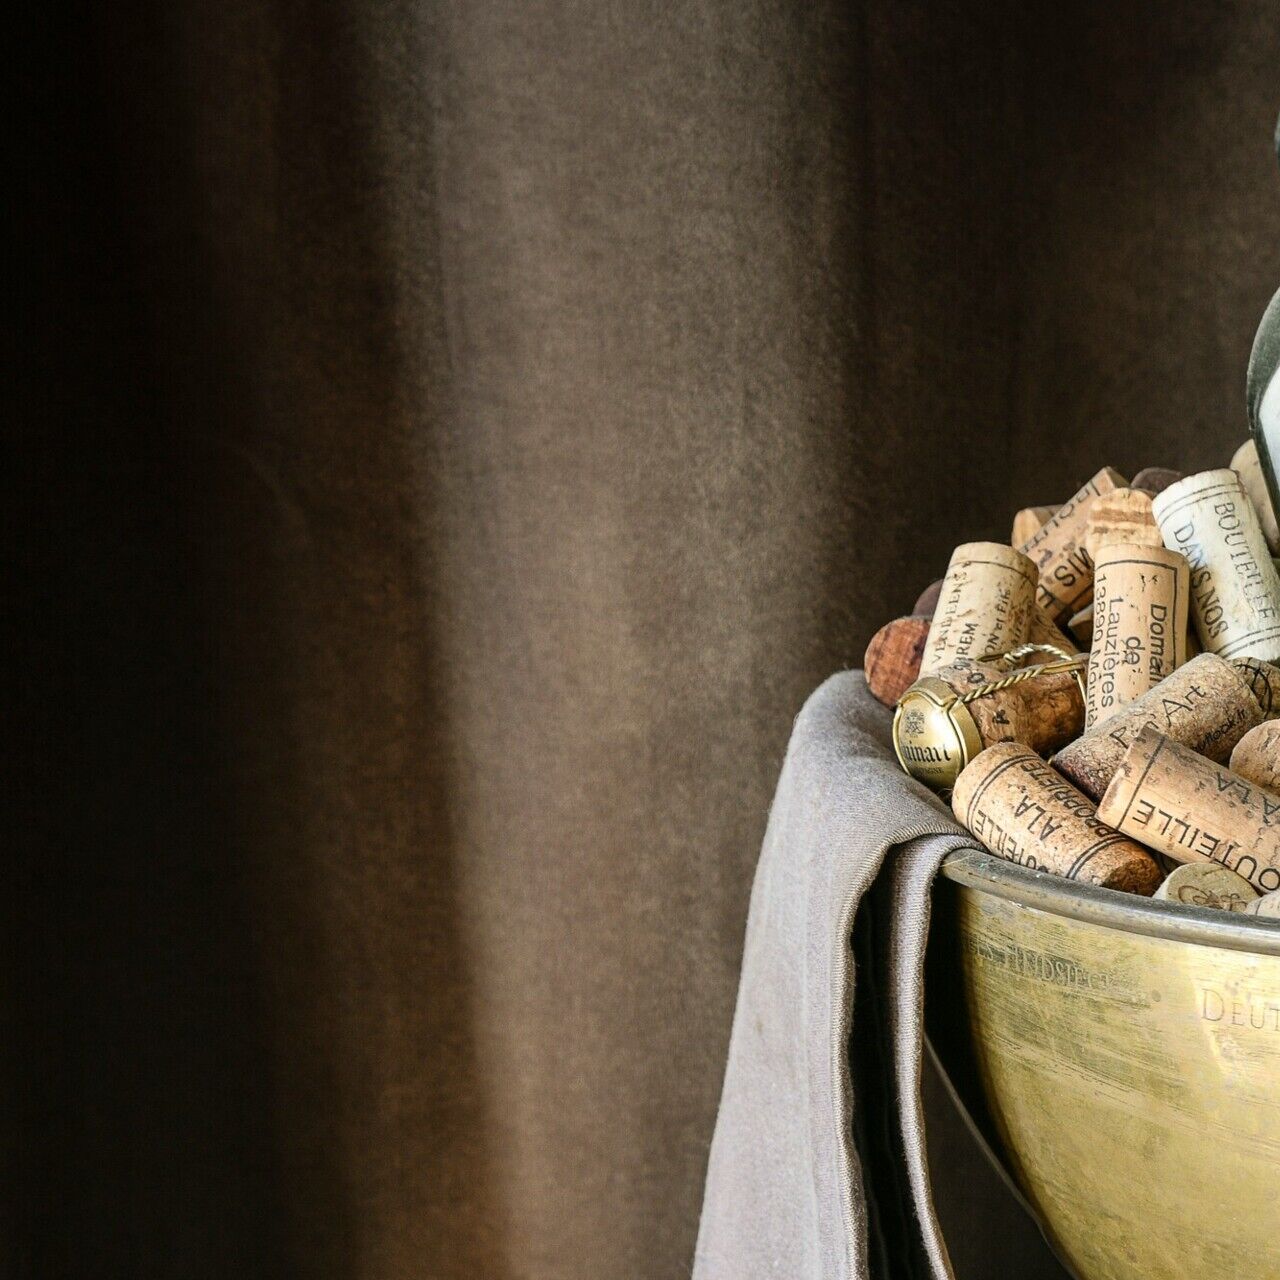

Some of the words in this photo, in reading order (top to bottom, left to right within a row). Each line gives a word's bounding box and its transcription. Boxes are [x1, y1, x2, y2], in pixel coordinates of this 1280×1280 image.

[1054, 546, 1092, 587] MIS
[1174, 522, 1212, 590] DANS
[1196, 586, 1229, 639] NOS
[1214, 501, 1276, 619] BOUTEILLE
[1100, 597, 1125, 708] Lauzières
[1125, 635, 1146, 666] de
[902, 740, 952, 764] uinart
